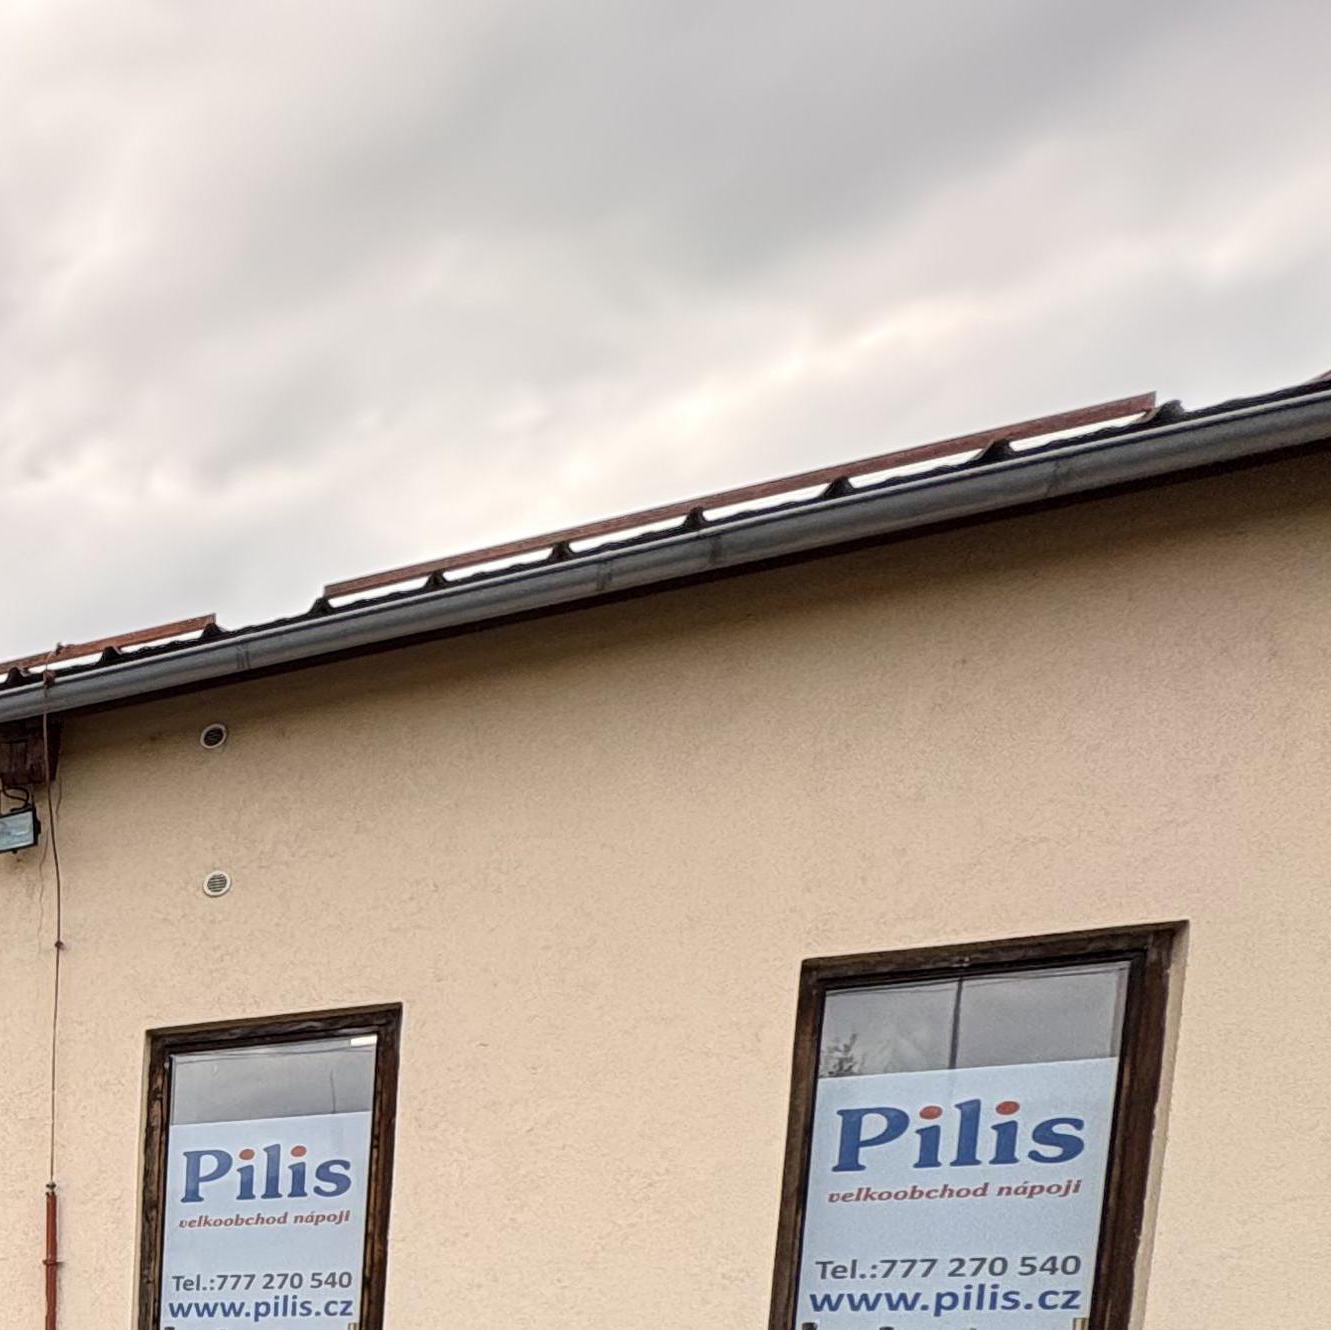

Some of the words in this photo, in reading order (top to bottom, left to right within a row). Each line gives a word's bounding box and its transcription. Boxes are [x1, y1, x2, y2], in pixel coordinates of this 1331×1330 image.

[831, 1098, 1085, 1173] Pilis
[180, 1143, 352, 1203] Pilis
[827, 1181, 989, 1203] velkoobchod
[997, 1179, 1082, 1202] nápoji
[178, 1211, 289, 1229] velkoobchod
[293, 1209, 350, 1227] nápoji
[815, 1257, 938, 1281] Tel.:777
[947, 1256, 1008, 1278] 270
[1018, 1254, 1082, 1276] 540
[172, 1273, 256, 1292] Tel.:777
[262, 1272, 303, 1290] 270
[310, 1271, 352, 1289] 540
[169, 1295, 353, 1321] www.pilis.cz
[809, 1283, 1082, 1317] www.pilis.cz
